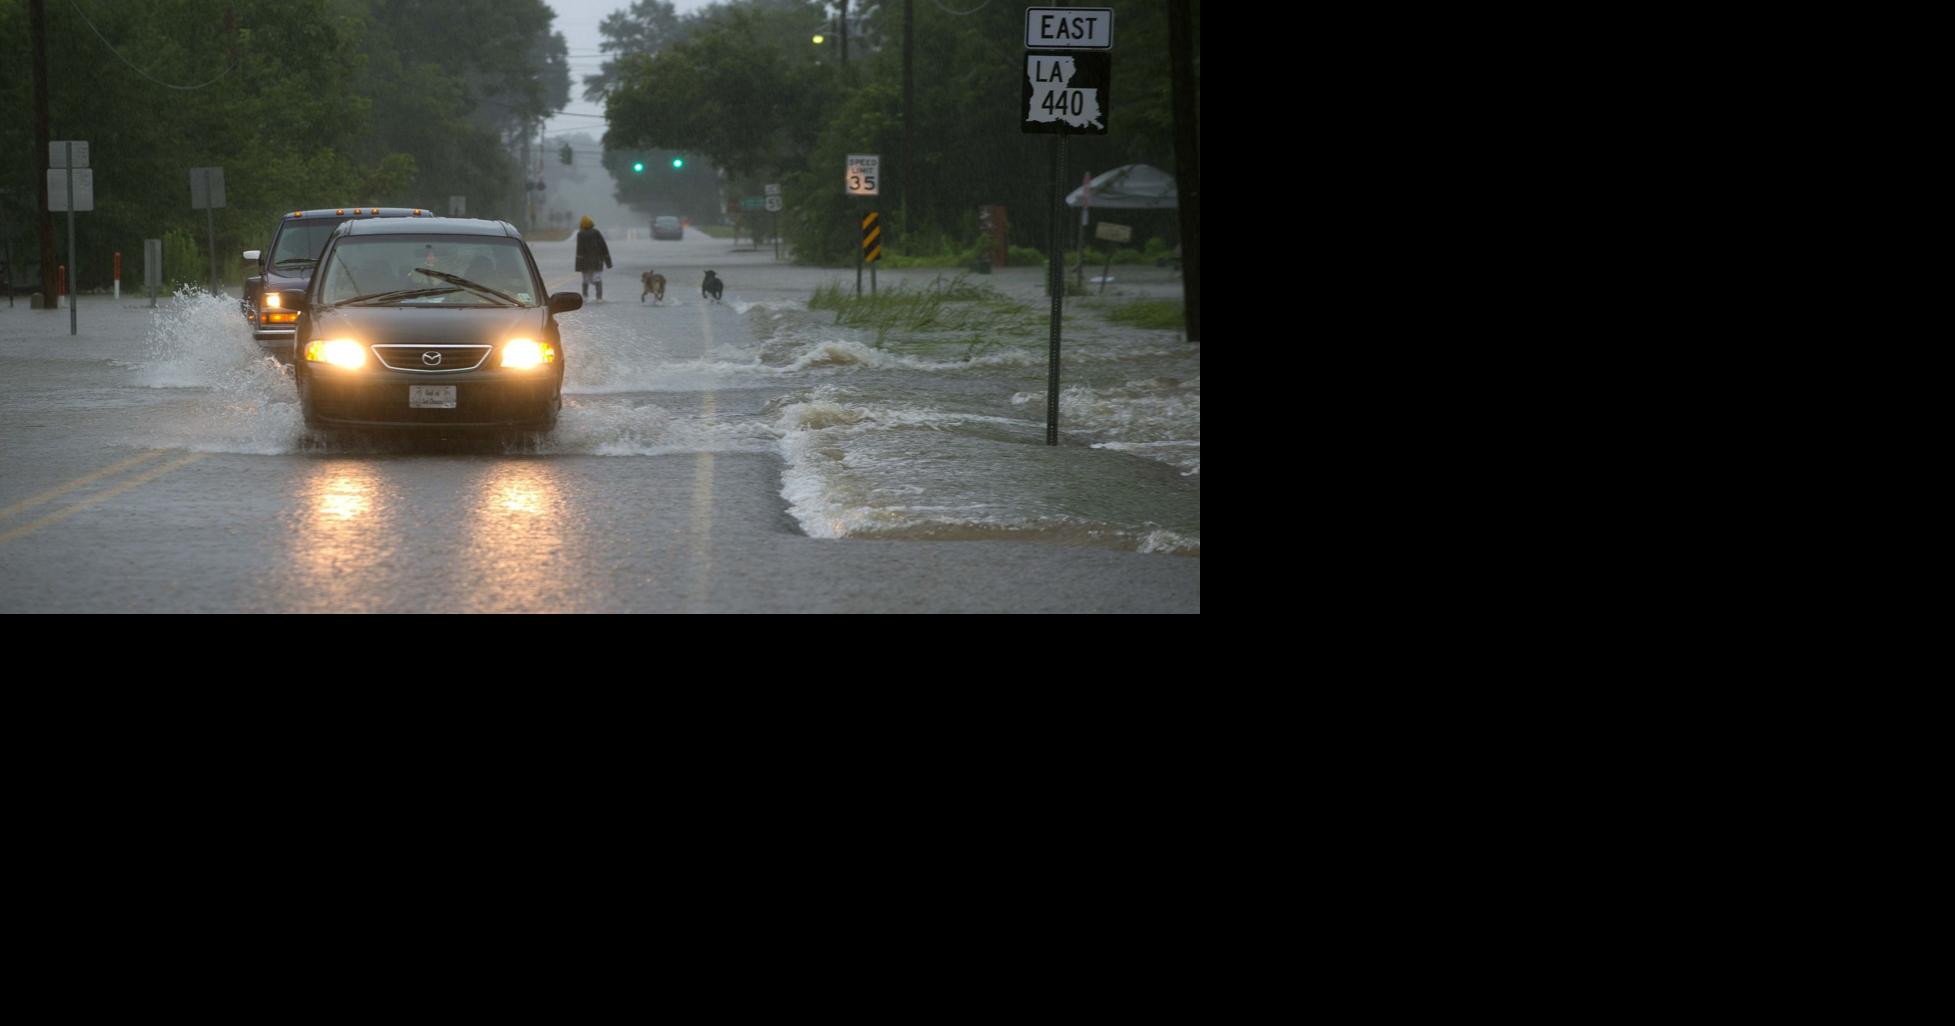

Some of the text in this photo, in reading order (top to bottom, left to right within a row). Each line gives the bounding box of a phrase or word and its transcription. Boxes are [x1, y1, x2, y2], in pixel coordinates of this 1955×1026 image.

[1040, 15, 1098, 40] EAST
[1036, 60, 1063, 83] LA
[1041, 90, 1083, 116] 440
[849, 158, 877, 166] SPEED
[849, 176, 875, 190] 35
